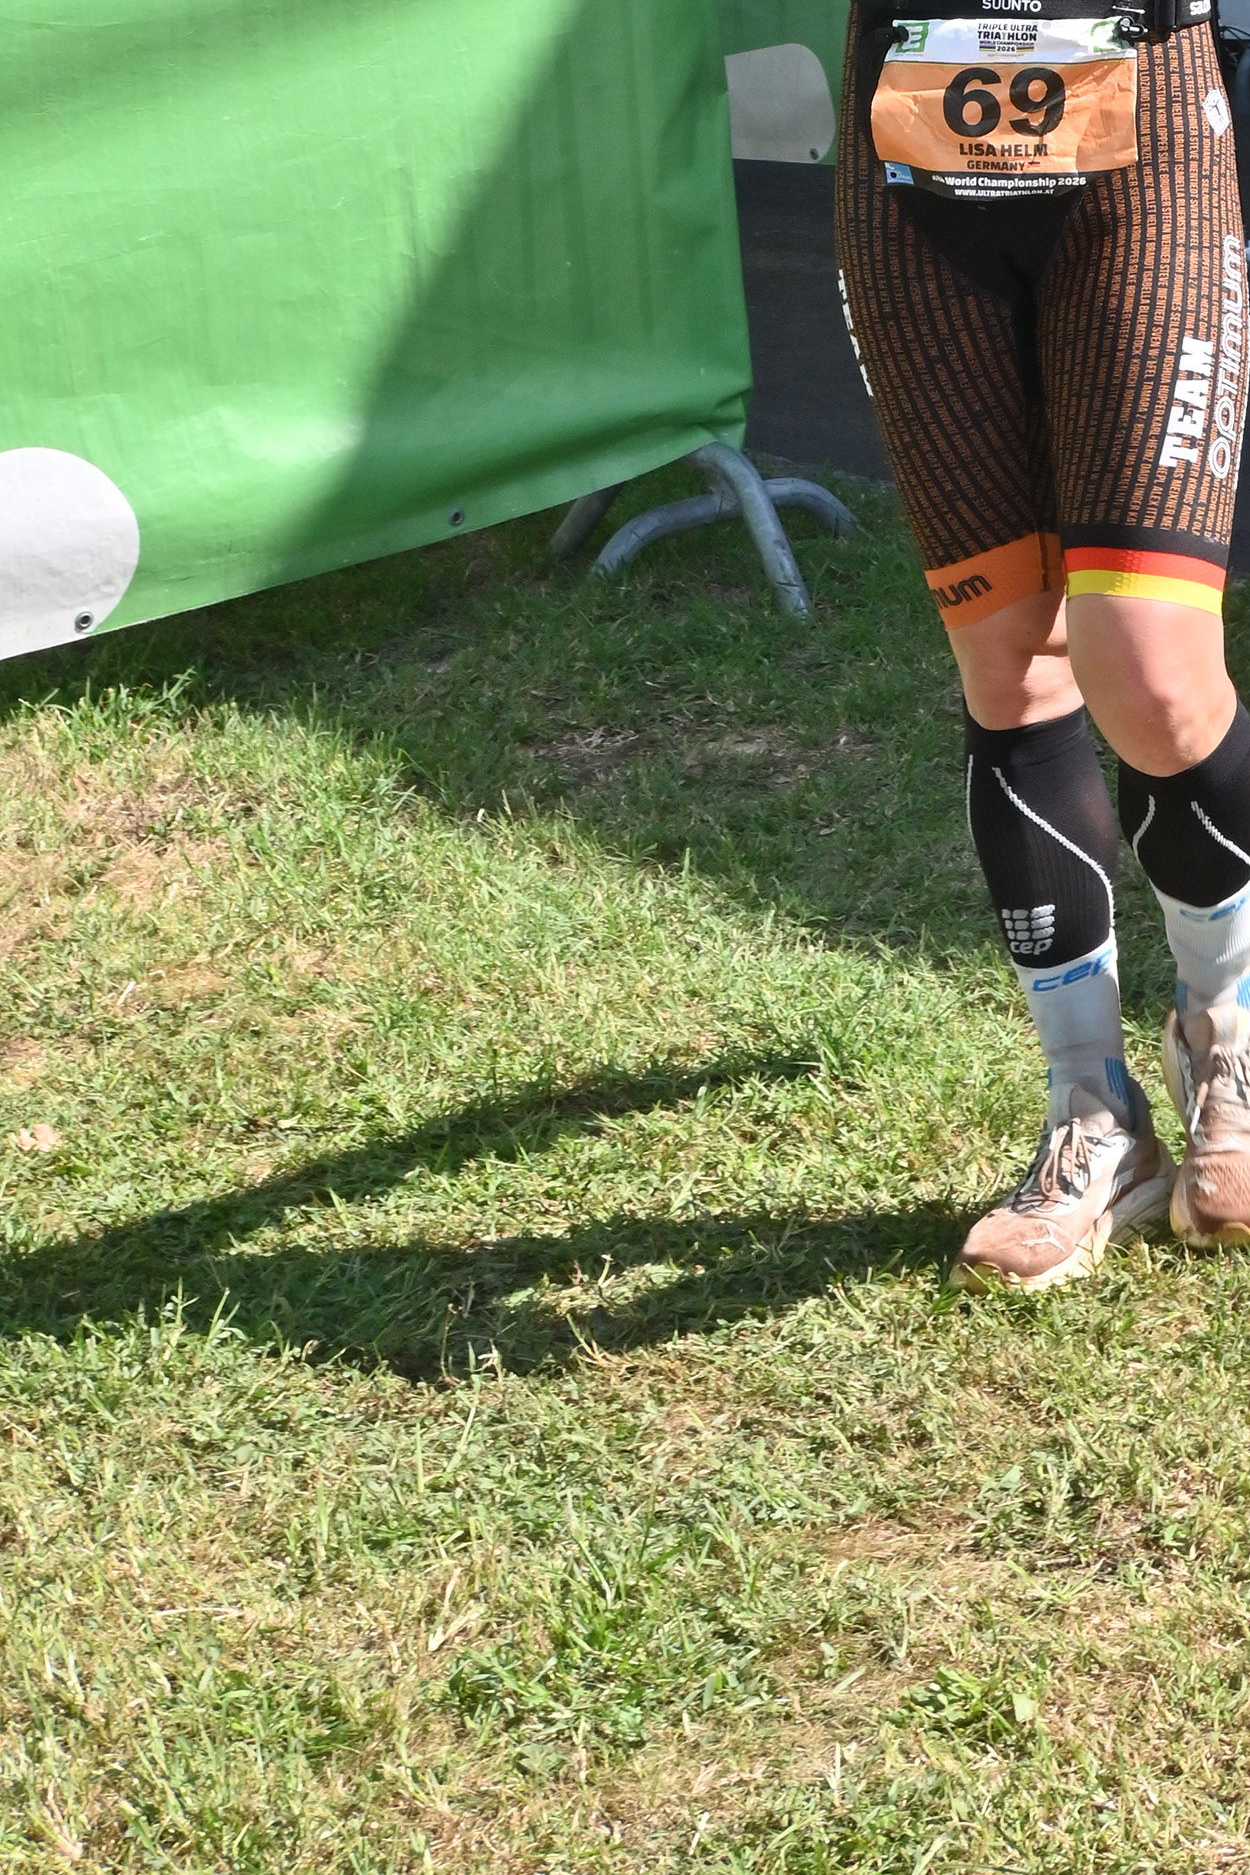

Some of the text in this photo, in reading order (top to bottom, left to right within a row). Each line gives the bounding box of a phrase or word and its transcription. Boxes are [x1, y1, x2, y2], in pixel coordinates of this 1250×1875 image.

[977, 23, 1038, 32] TRIPLE ULTRA
[977, 31, 1037, 42] TRIATHLON
[942, 66, 1066, 138] 69
[959, 143, 1048, 157] LISA HELM
[967, 160, 1026, 172] GERMANY
[945, 176, 977, 187] World
[978, 176, 1057, 188] Championship
[1057, 177, 1087, 186] 2026
[1210, 235, 1246, 479] optimum
[1158, 336, 1214, 468] TEAM
[1009, 938, 1054, 956] cep
